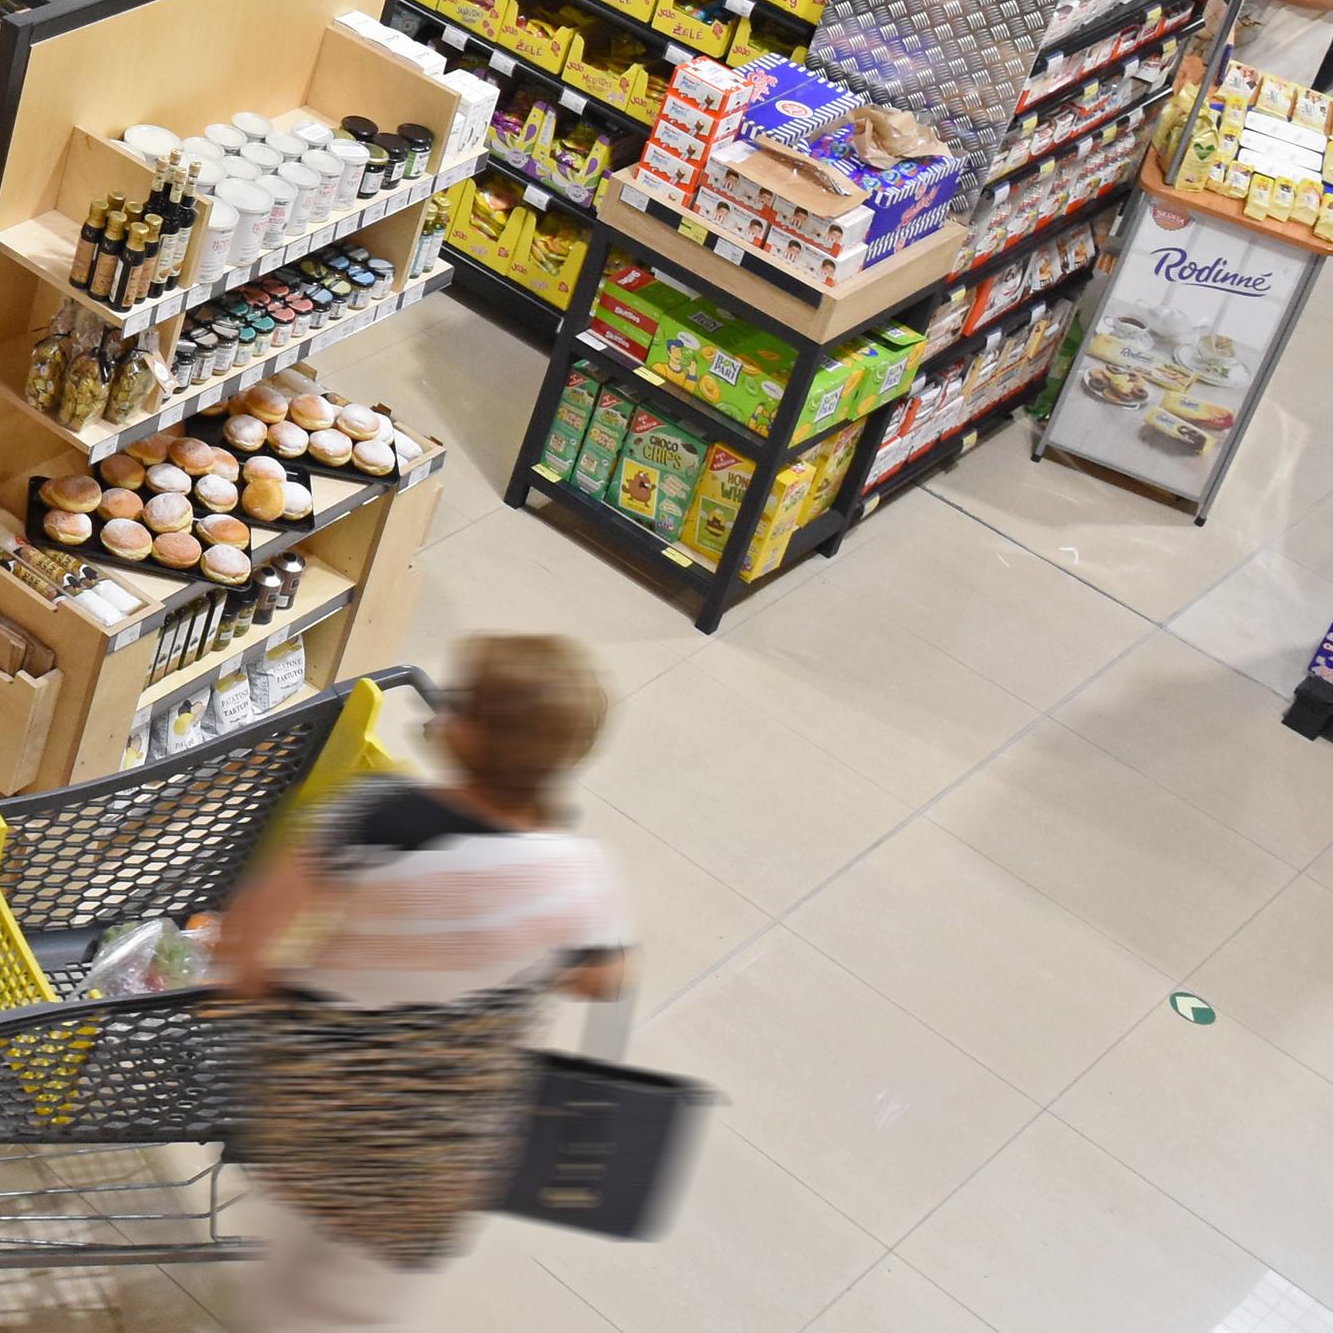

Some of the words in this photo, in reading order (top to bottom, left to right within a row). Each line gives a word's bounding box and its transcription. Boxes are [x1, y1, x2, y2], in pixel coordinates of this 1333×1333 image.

[672, 21, 703, 41] ŽELÉ
[1151, 247, 1273, 297] Rodinné
[713, 362, 737, 384] PARI
[716, 354, 739, 375] BON
[649, 435, 679, 454] CHOCO
[643, 445, 682, 470] CHIPS
